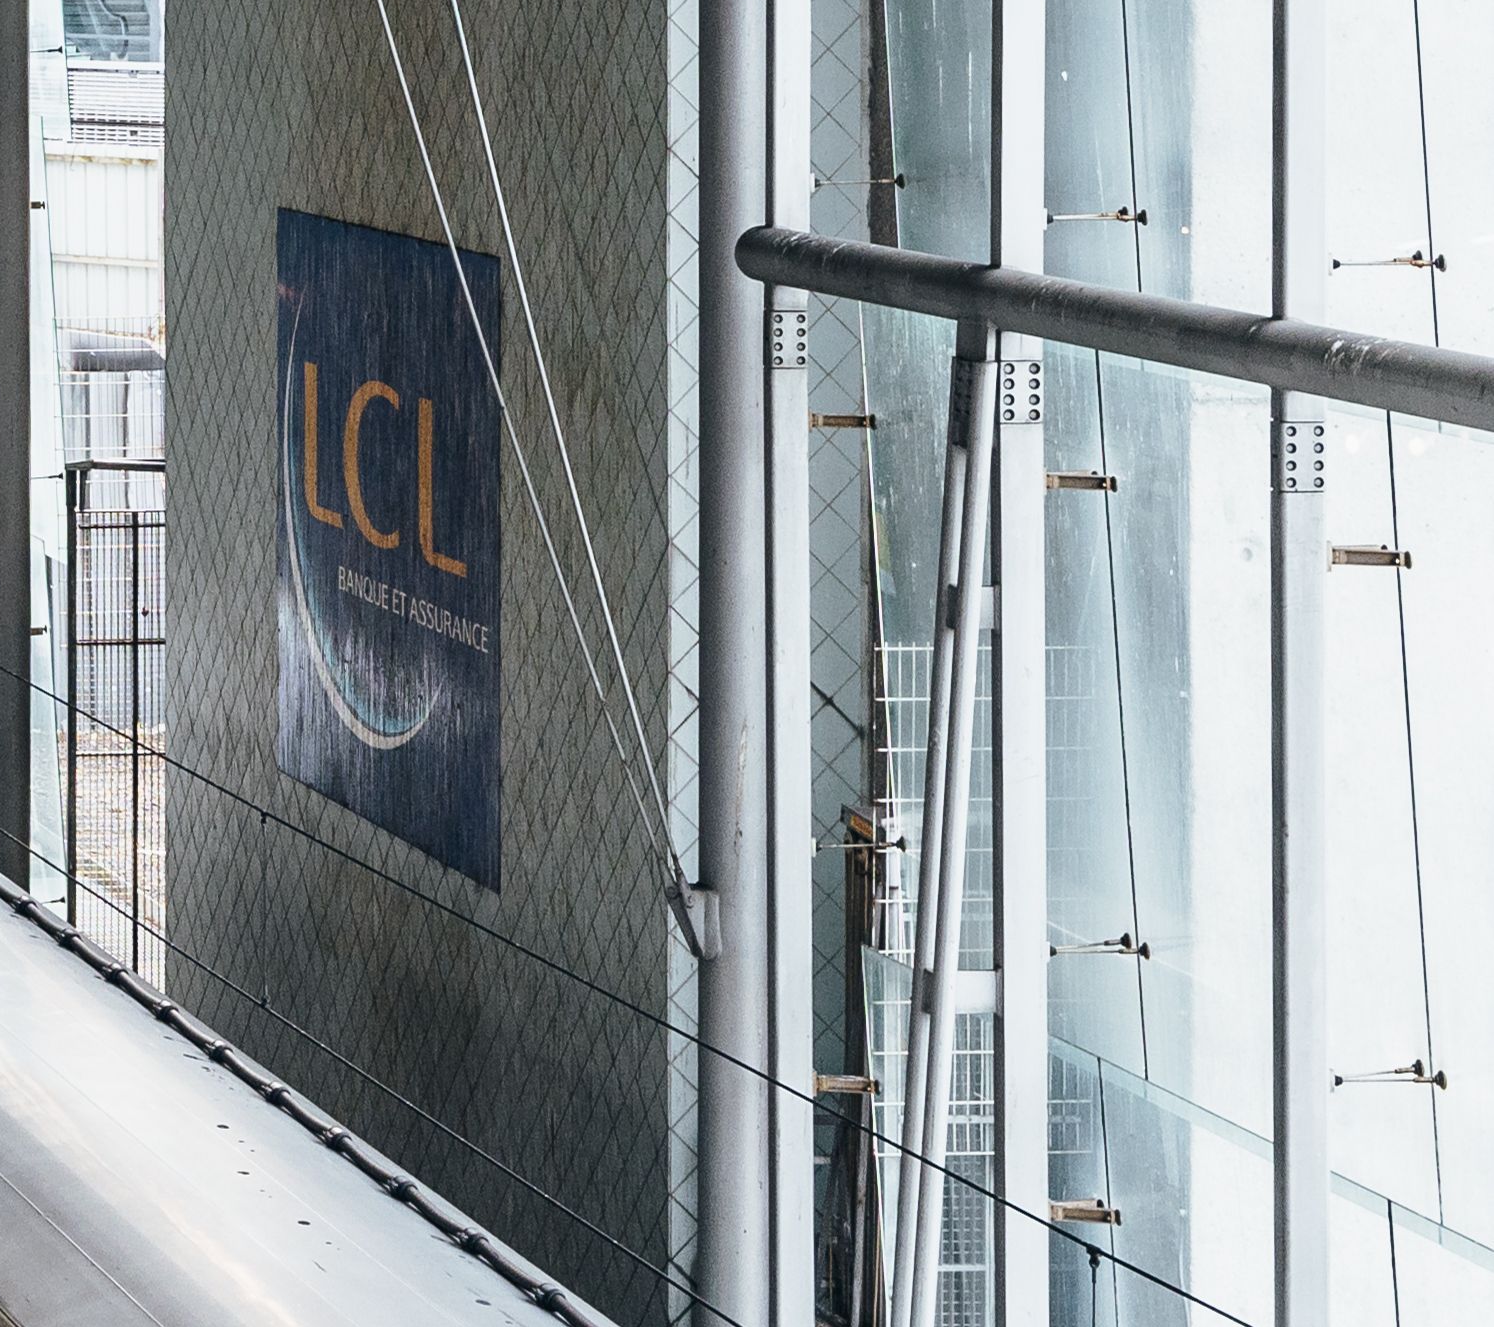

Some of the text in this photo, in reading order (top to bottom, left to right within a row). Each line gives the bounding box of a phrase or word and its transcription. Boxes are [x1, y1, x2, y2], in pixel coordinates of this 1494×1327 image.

[303, 361, 468, 578] LCL
[338, 565, 489, 653] BANQUE ET ASSURANCE
